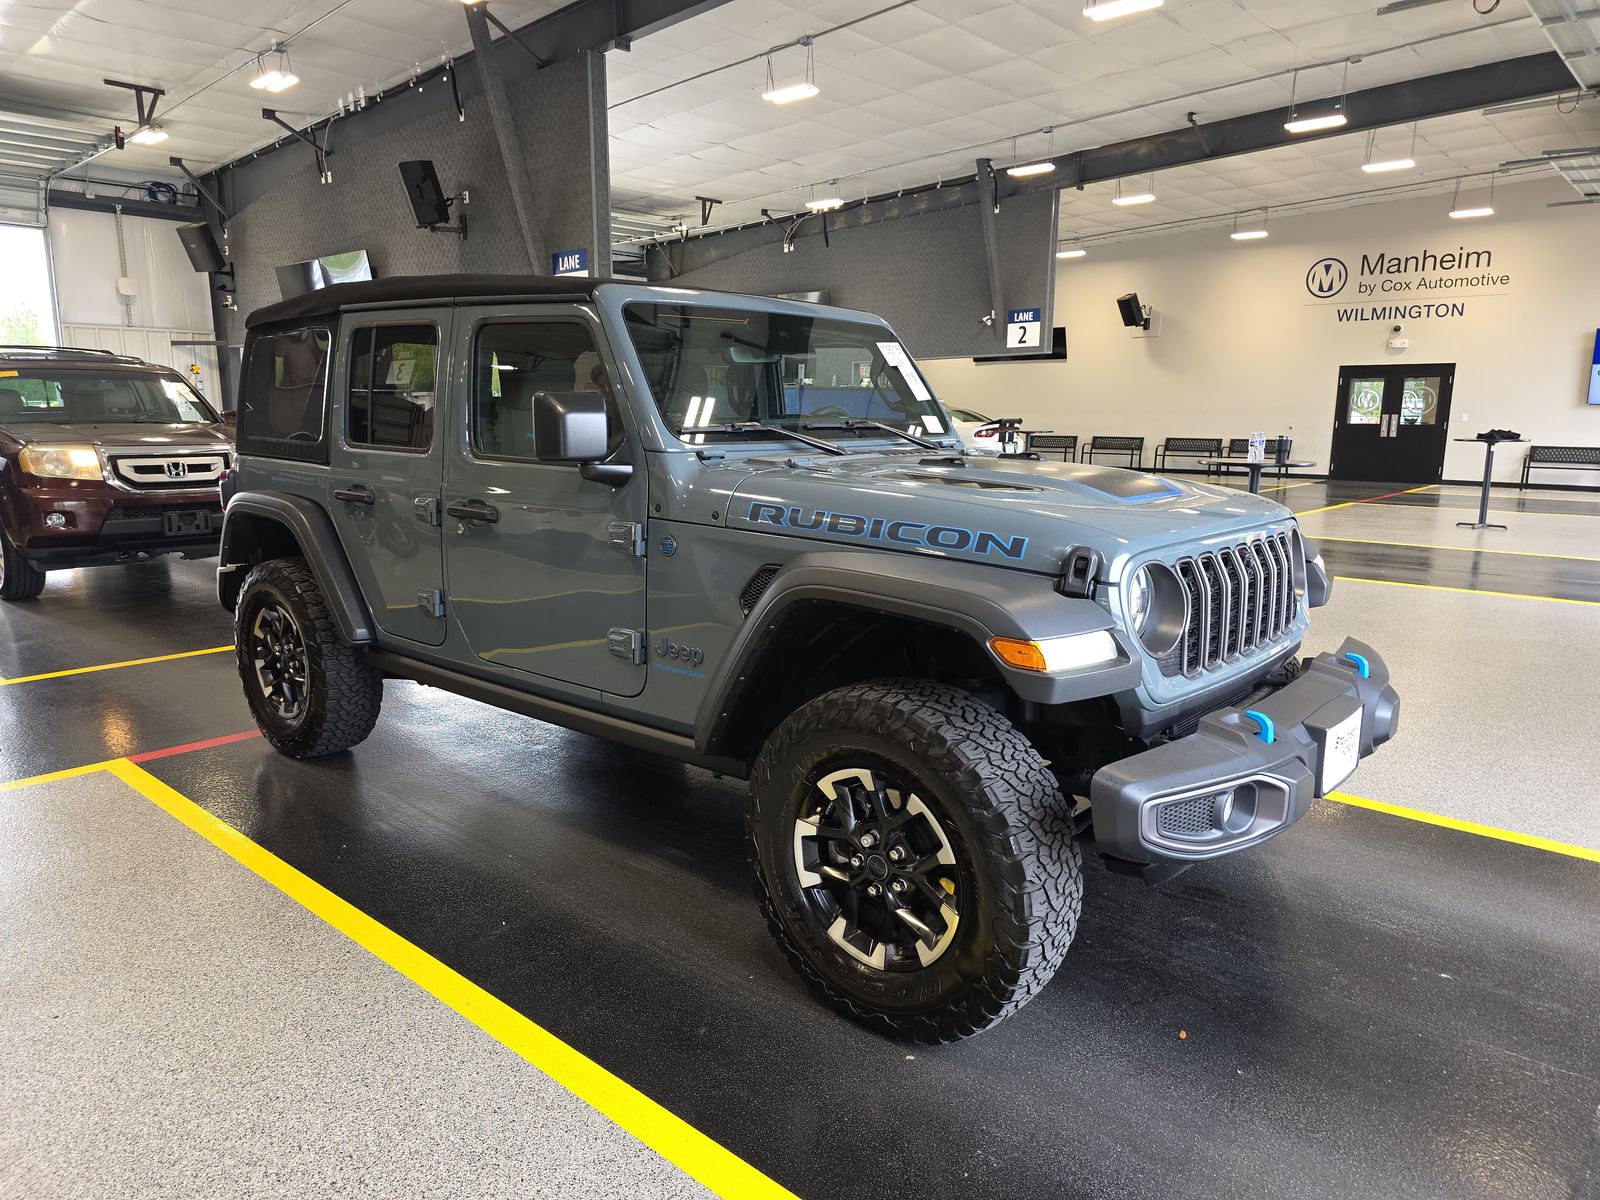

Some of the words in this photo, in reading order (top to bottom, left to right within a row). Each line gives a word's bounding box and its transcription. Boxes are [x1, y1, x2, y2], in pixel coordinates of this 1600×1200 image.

[559, 254, 580, 271] LANE
[1360, 247, 1492, 276] Manheim
[1358, 281, 1376, 297] by
[1381, 279, 1412, 292] Cox
[1416, 273, 1510, 290] Automotive
[1014, 311, 1034, 322] LANE
[1337, 303, 1465, 322] WILMINGTON
[1018, 325, 1027, 344] 2
[749, 502, 1029, 560] RUBICON
[654, 635, 704, 668] Jeep
